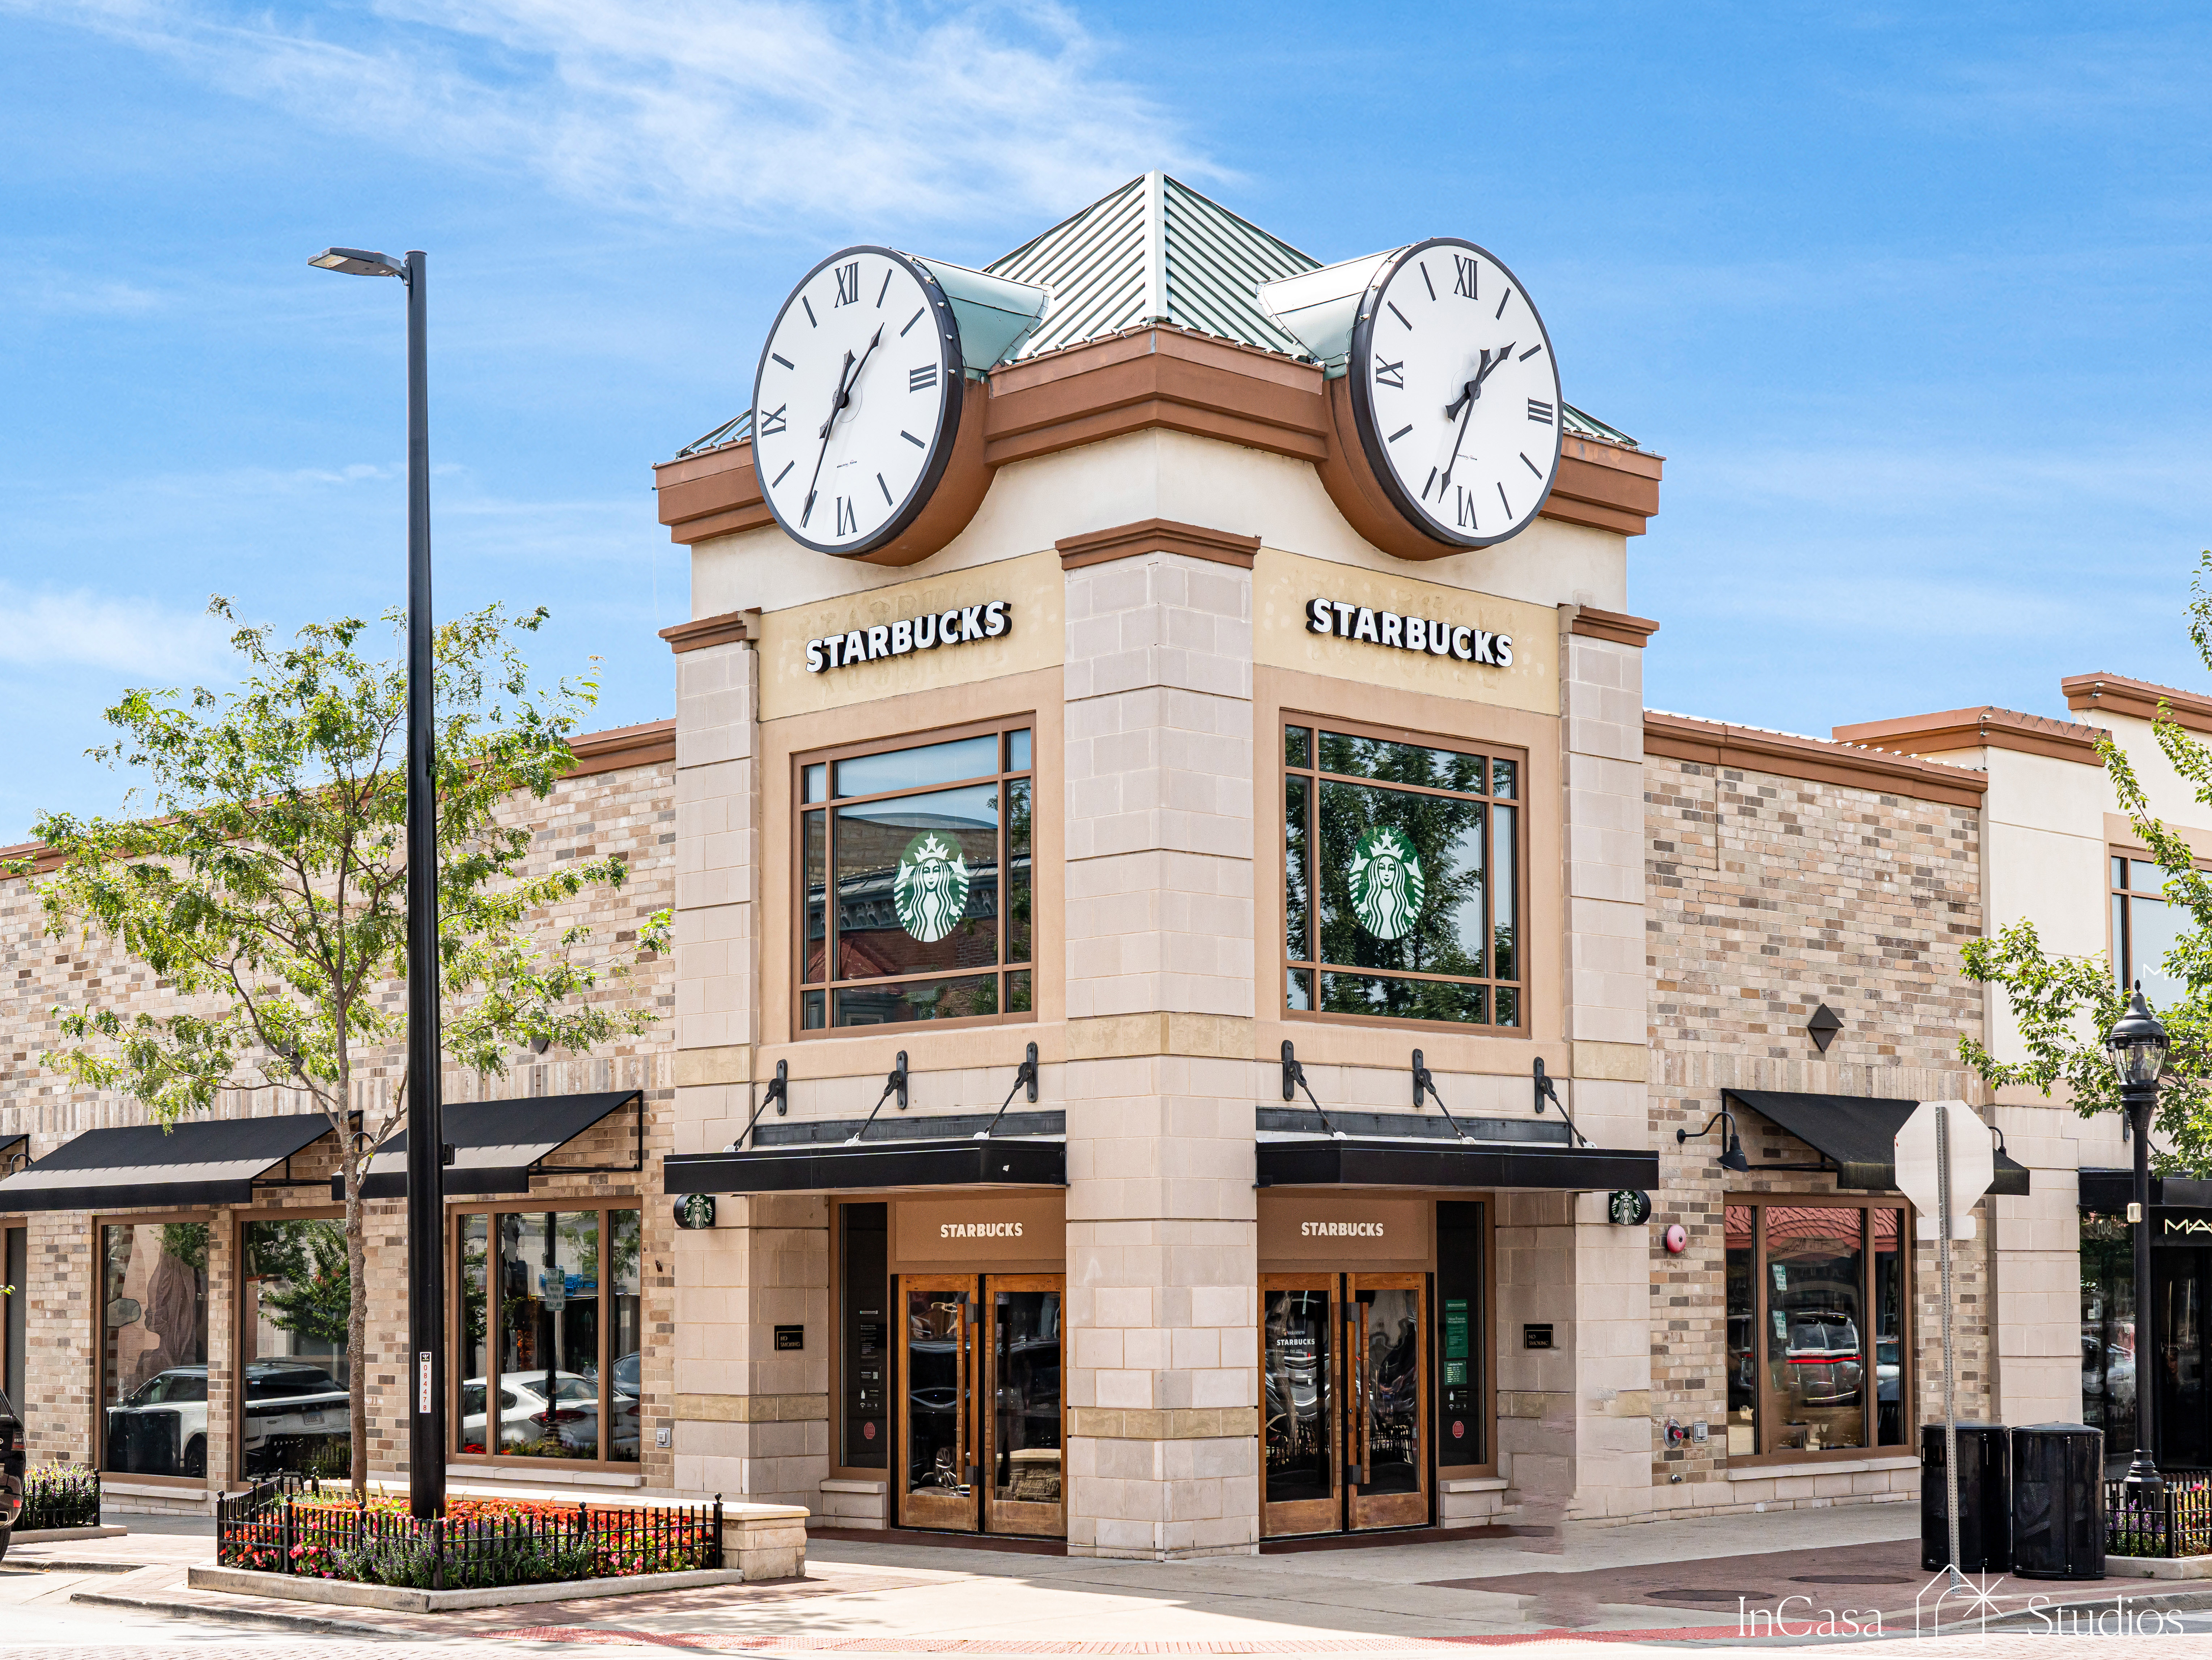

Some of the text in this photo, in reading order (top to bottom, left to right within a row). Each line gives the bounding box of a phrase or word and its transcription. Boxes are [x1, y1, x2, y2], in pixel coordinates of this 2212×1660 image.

[834, 261, 859, 308] XII
[1453, 254, 1478, 300] XII
[910, 362, 937, 393] III
[1528, 397, 1553, 427] III
[805, 600, 1012, 673] STARBUCKS
[1305, 597, 1513, 668] STARBUCKS
[941, 1222, 1023, 1238] STARBUCKS
[1301, 1222, 1384, 1237] STARBUCKS
